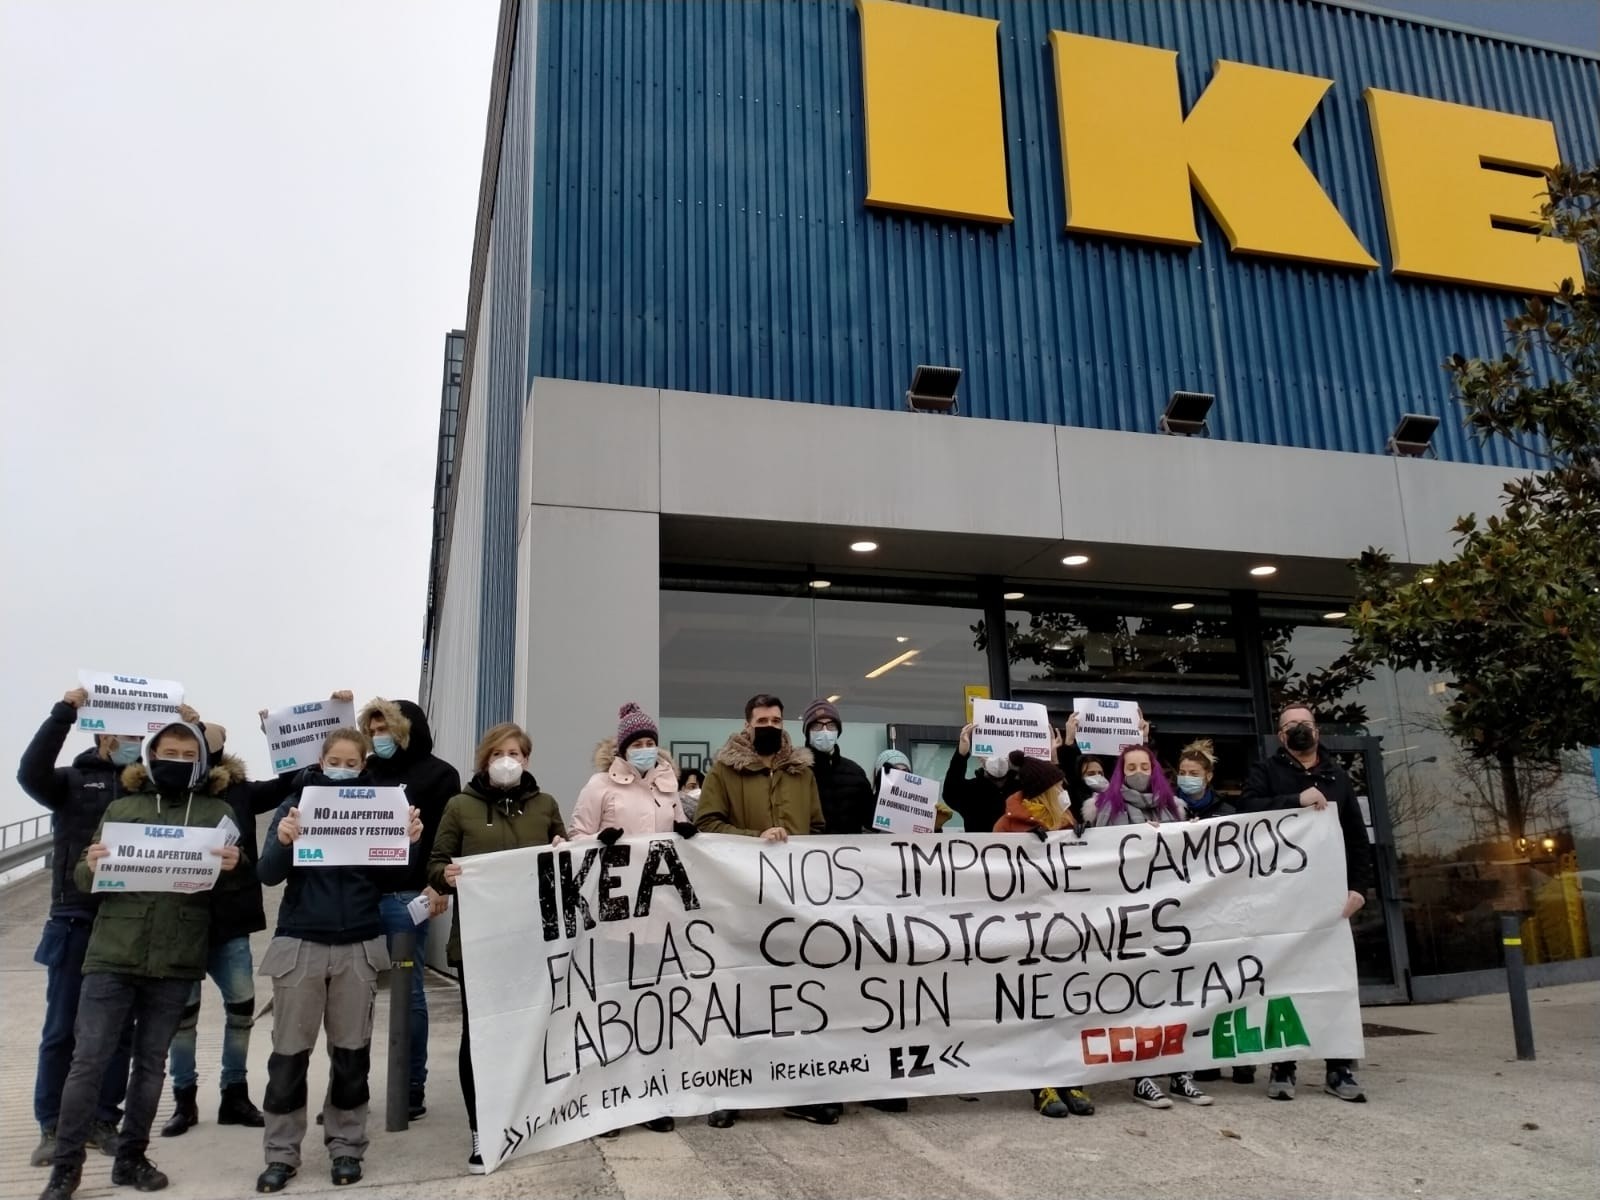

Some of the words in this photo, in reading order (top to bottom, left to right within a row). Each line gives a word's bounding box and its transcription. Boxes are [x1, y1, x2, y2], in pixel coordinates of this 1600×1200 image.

[94, 684, 110, 694] NO
[118, 688, 128, 696] LA
[129, 689, 168, 699] APERTURA
[92, 700, 136, 710] DOMINGOS
[136, 702, 142, 711] Y
[144, 703, 180, 714] FESTIVOS
[80, 718, 105, 728] ELA
[279, 723, 292, 736] NO
[298, 723, 306, 731] LA
[306, 717, 340, 730] APERTURA
[984, 714, 996, 724] NO
[1008, 718, 1038, 726] APERTURA
[281, 734, 314, 748] DOMINGOS
[315, 732, 320, 740] Y
[984, 728, 1014, 738] DOMINGOS
[1015, 730, 1020, 738] Y
[1020, 730, 1046, 739] FESTIVOS
[974, 744, 993, 752] ELA
[276, 757, 296, 768] ELA
[314, 807, 330, 820] NO
[332, 810, 338, 820] A
[340, 810, 350, 820] LA
[350, 810, 394, 820] APERTURA
[310, 826, 357, 836] DOMINGOS
[359, 826, 365, 836] Y
[366, 826, 405, 836] FESTIVOS
[117, 844, 135, 858] NO
[136, 849, 142, 858] A
[144, 848, 155, 859] LA
[156, 850, 202, 860] APERTURA
[298, 848, 324, 858] ELA
[100, 864, 112, 872] EN
[113, 864, 162, 874] DOMINGOS
[165, 866, 172, 874] Y
[172, 866, 214, 876] FESTIVOS
[97, 880, 126, 888] ELA
[537, 839, 701, 942] IKEA
[758, 846, 864, 906] NOS
[891, 839, 1091, 902] IMPONE
[1118, 813, 1308, 894] CAMBIOS
[546, 938, 597, 1015] EN
[629, 919, 716, 990] LAS
[759, 898, 1192, 971] CONDICIONES
[543, 979, 829, 1085] LABORALES
[860, 971, 950, 1033] SIN
[995, 955, 1265, 1024] NEGOCIAR
[602, 1086, 631, 1109] ETA
[681, 1067, 752, 1090] EGUNEN
